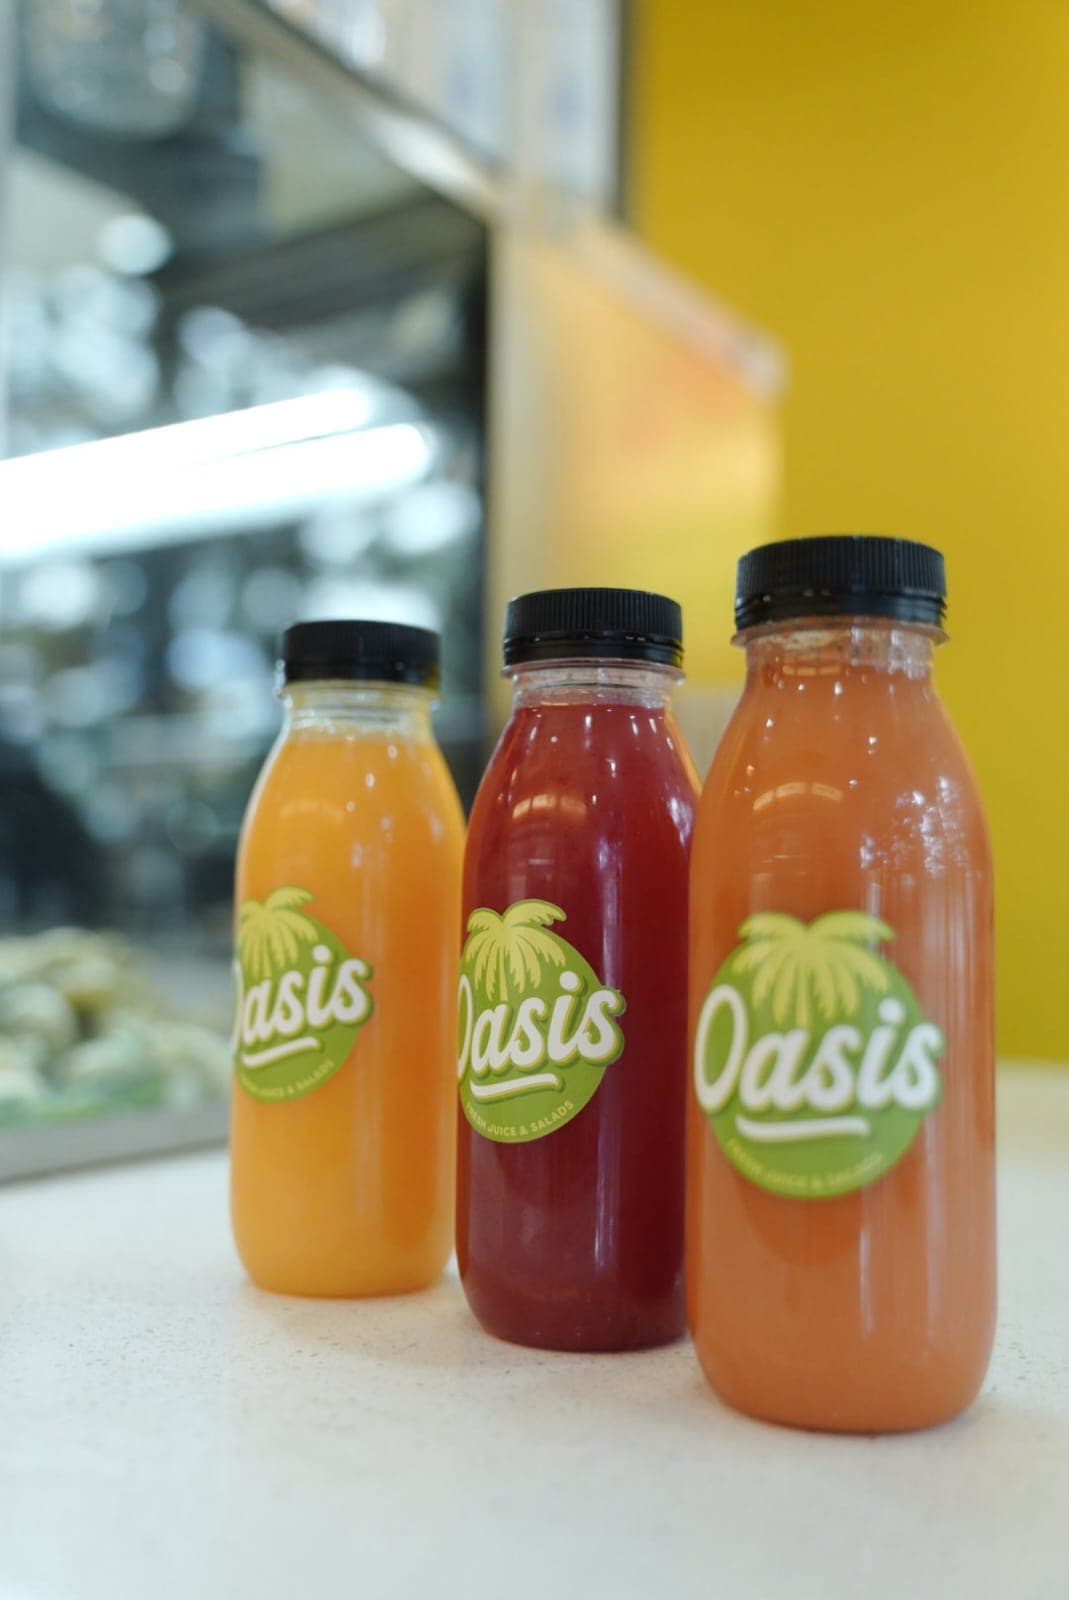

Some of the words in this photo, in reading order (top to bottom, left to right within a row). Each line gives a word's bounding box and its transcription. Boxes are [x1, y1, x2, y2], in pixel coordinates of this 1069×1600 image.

[457, 971, 617, 1080] Oasis
[694, 984, 942, 1112] Oasis
[487, 1123, 517, 1137] JUICE
[519, 1124, 529, 1136] &
[530, 1100, 574, 1132] SALADS
